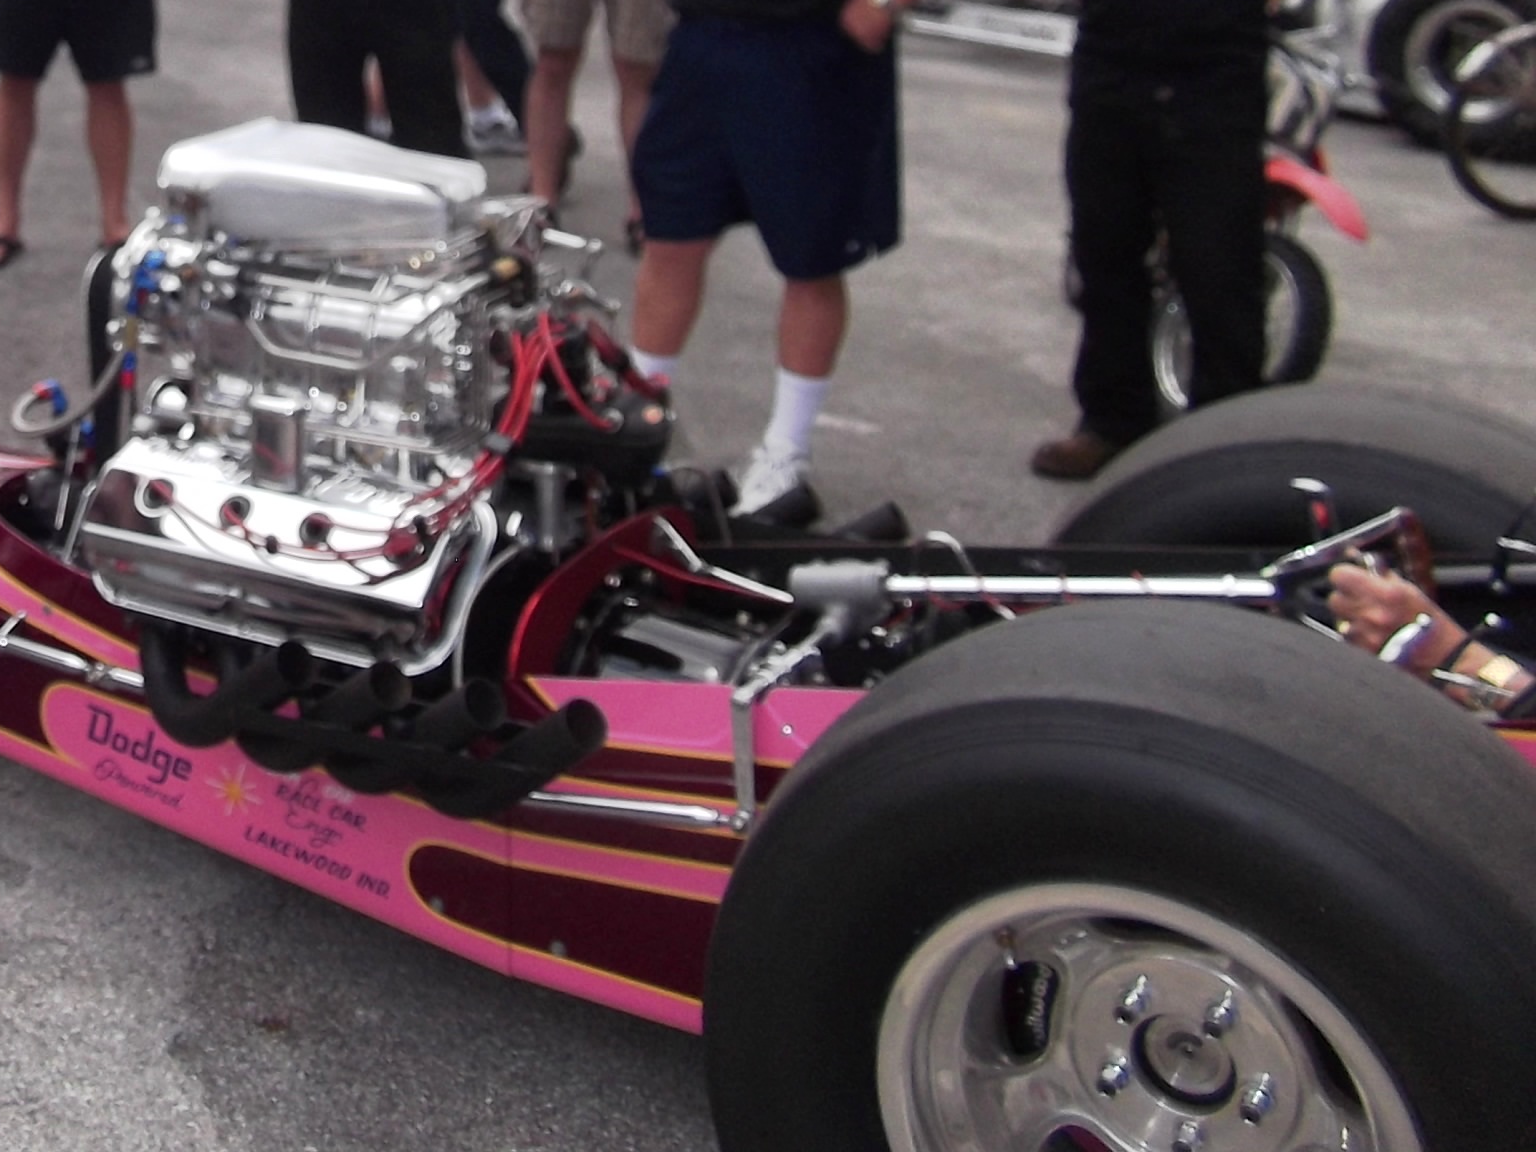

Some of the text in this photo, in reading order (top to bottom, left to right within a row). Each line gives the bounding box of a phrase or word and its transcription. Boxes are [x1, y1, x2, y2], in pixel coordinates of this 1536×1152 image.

[87, 704, 192, 784] Dodge
[94, 758, 185, 809] Powered
[328, 805, 368, 832] CAR
[244, 825, 352, 881] LAKEWOOD
